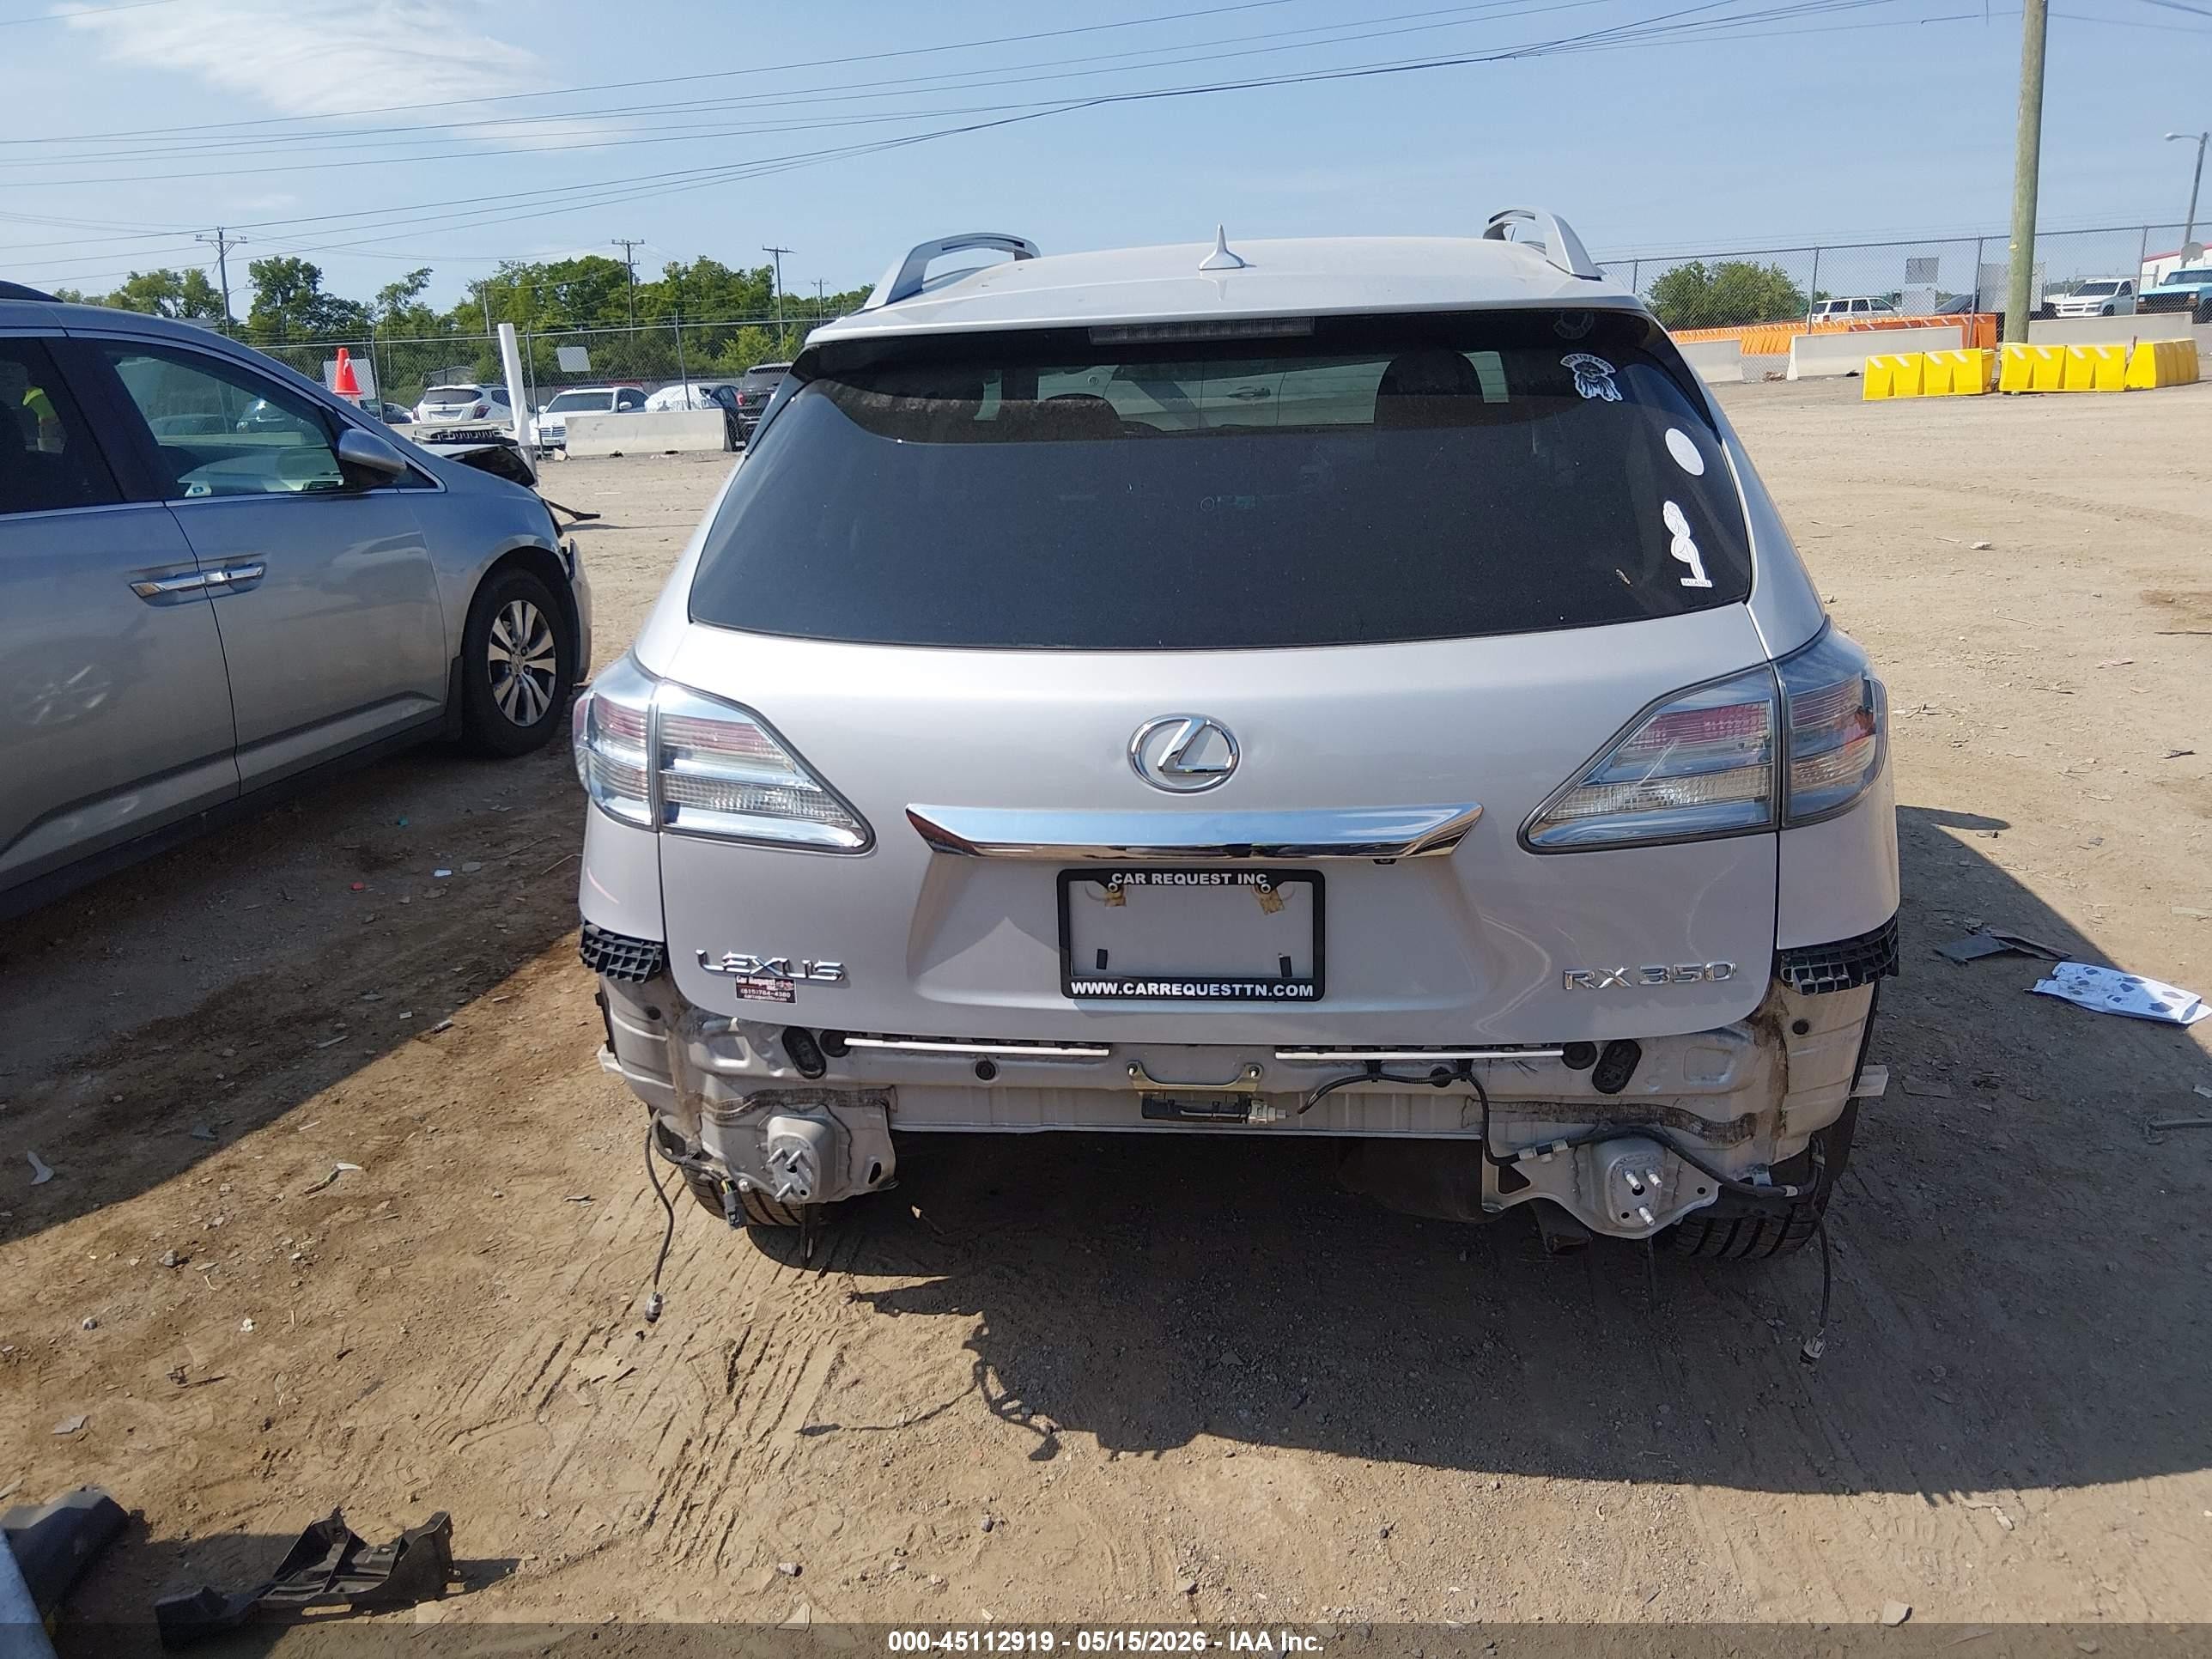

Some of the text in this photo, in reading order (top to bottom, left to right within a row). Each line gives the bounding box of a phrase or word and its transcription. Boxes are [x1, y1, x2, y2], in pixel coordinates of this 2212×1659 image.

[1111, 872, 1268, 885] CAR REQUEST INC
[695, 948, 846, 981] LEXUS
[1563, 961, 1737, 989] RX 350
[1071, 981, 1314, 997] WWW.CARREQUESTTN.COM
